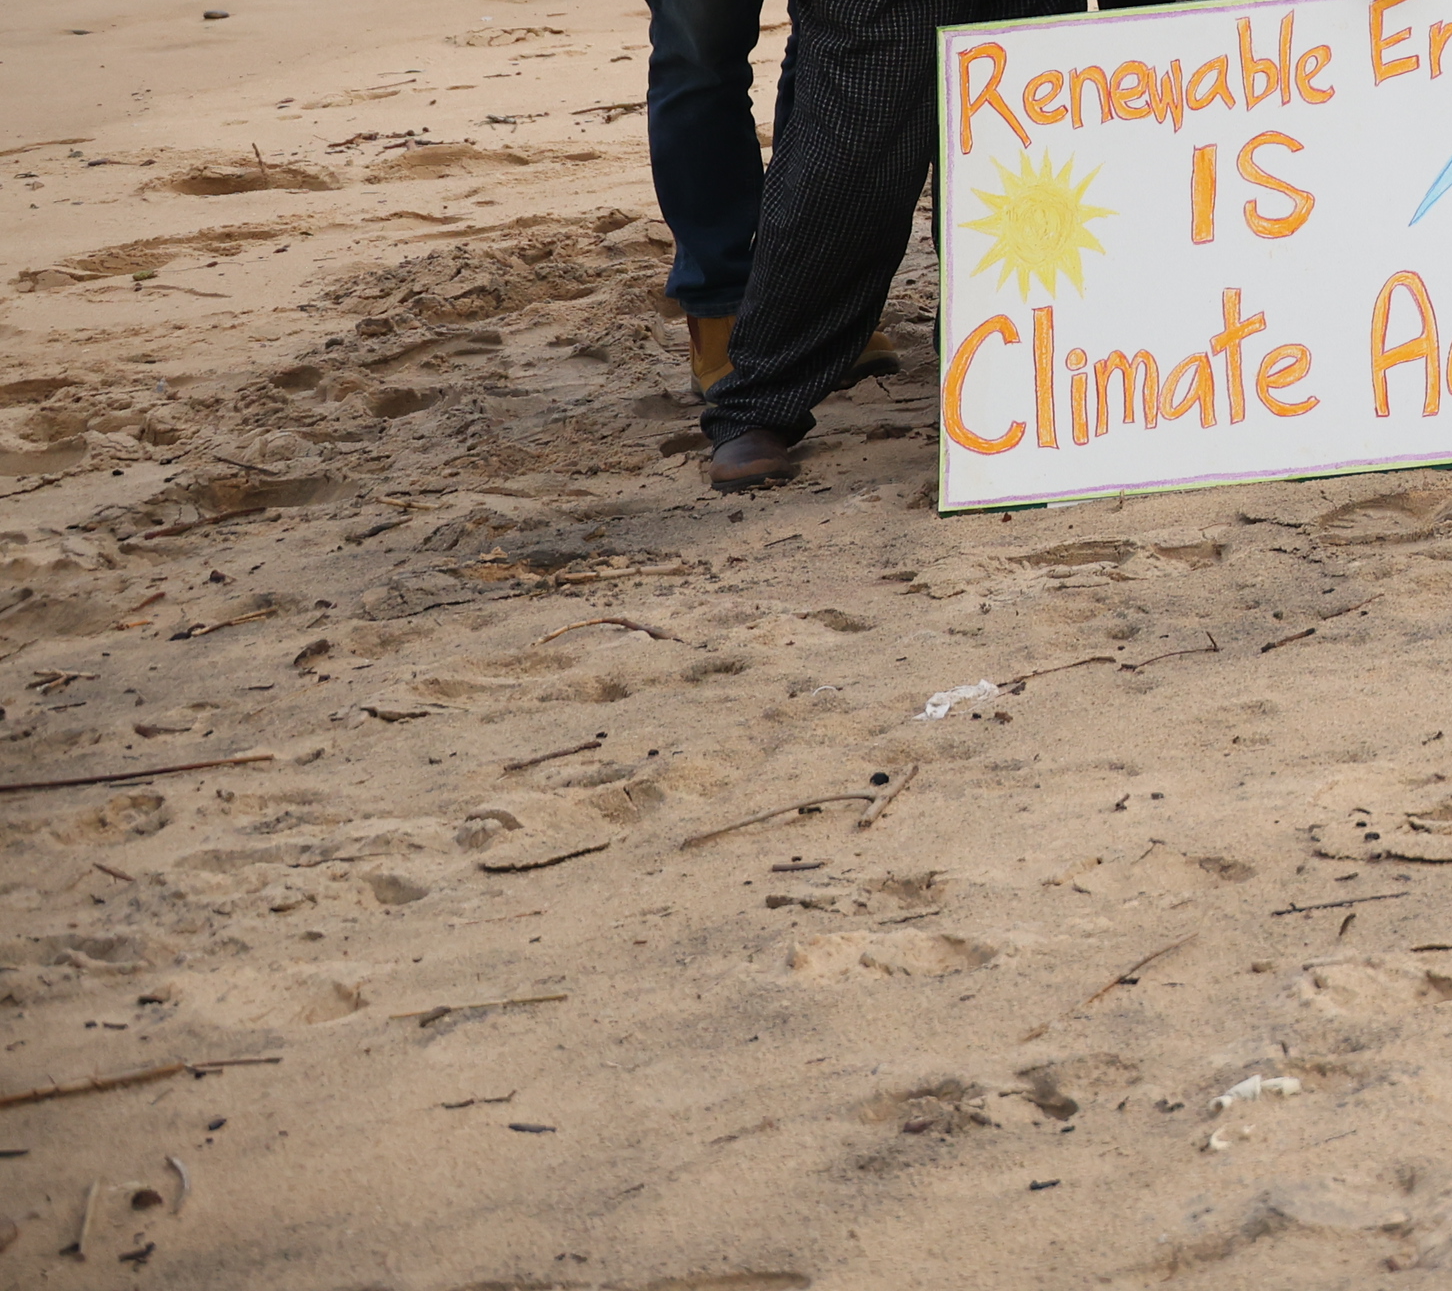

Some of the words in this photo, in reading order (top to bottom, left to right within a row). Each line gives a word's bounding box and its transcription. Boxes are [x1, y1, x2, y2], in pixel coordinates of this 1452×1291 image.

[957, 10, 1335, 155] Renewable
[1191, 130, 1316, 246] IS
[942, 287, 1320, 456] Climate
